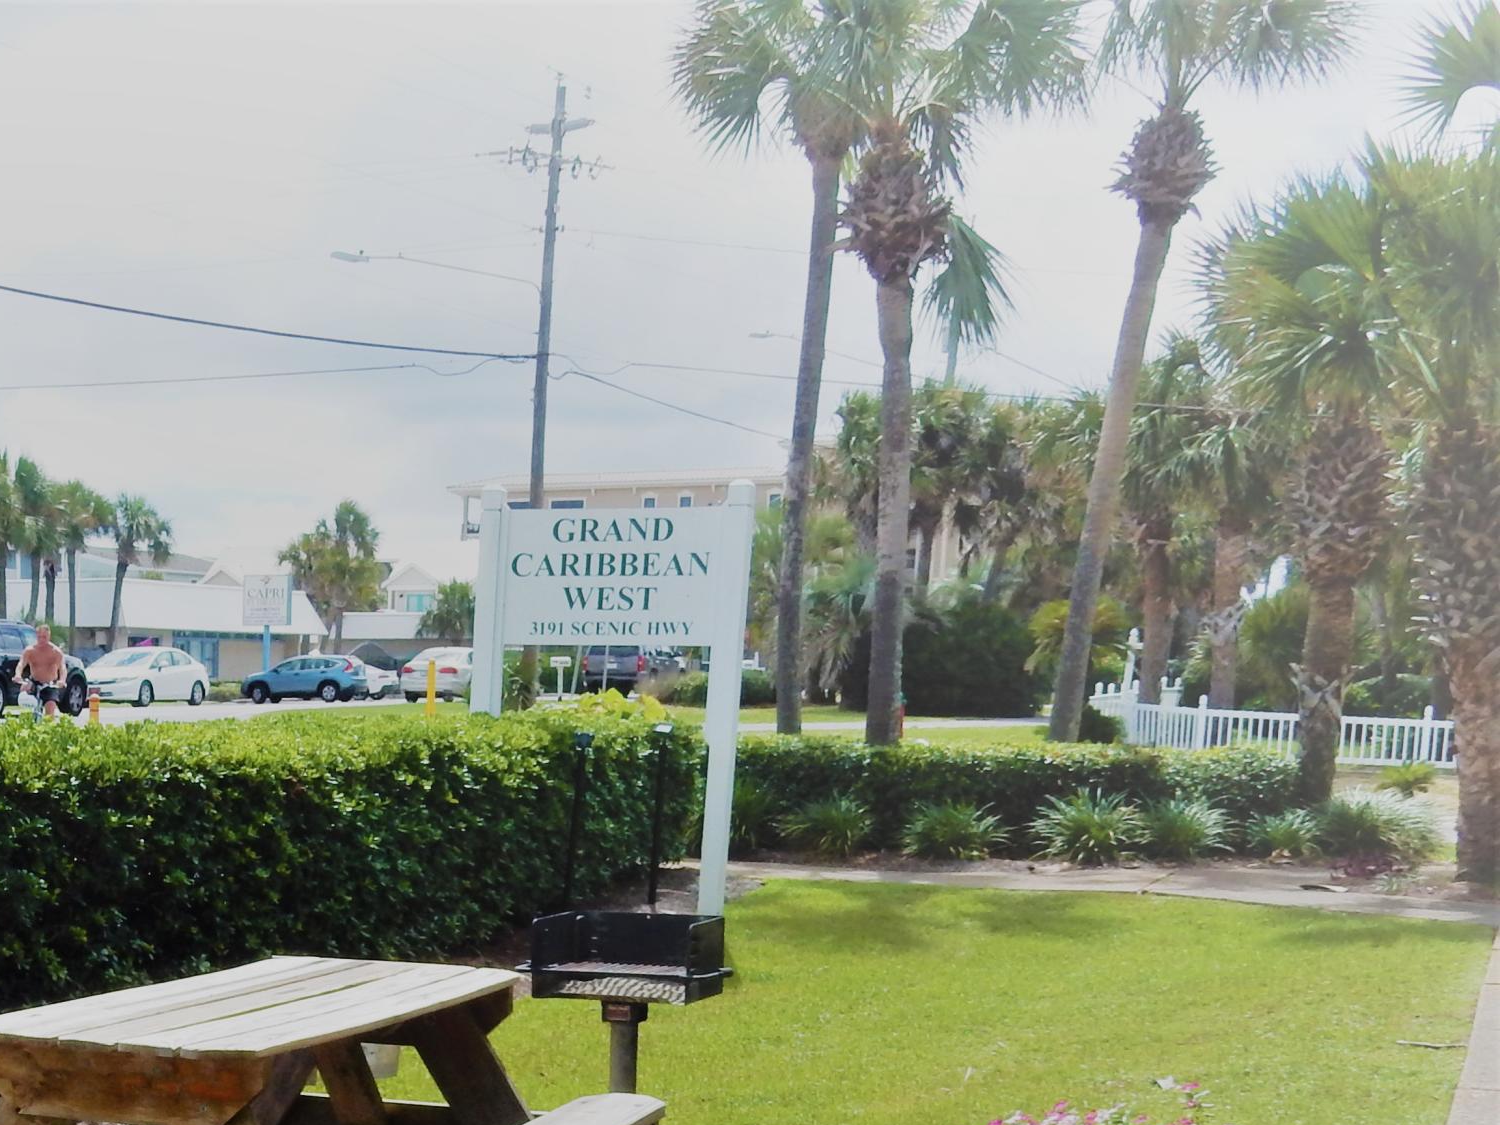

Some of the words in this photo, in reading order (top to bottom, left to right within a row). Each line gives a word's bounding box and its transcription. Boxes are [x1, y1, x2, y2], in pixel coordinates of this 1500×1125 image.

[552, 517, 674, 543] GRAND
[511, 551, 711, 577] CARIBBEAN
[247, 588, 285, 600] CAPRI
[563, 586, 658, 611] WEST
[529, 621, 564, 636] 3191
[570, 621, 642, 636] SCENIC
[648, 621, 694, 635] HWY
